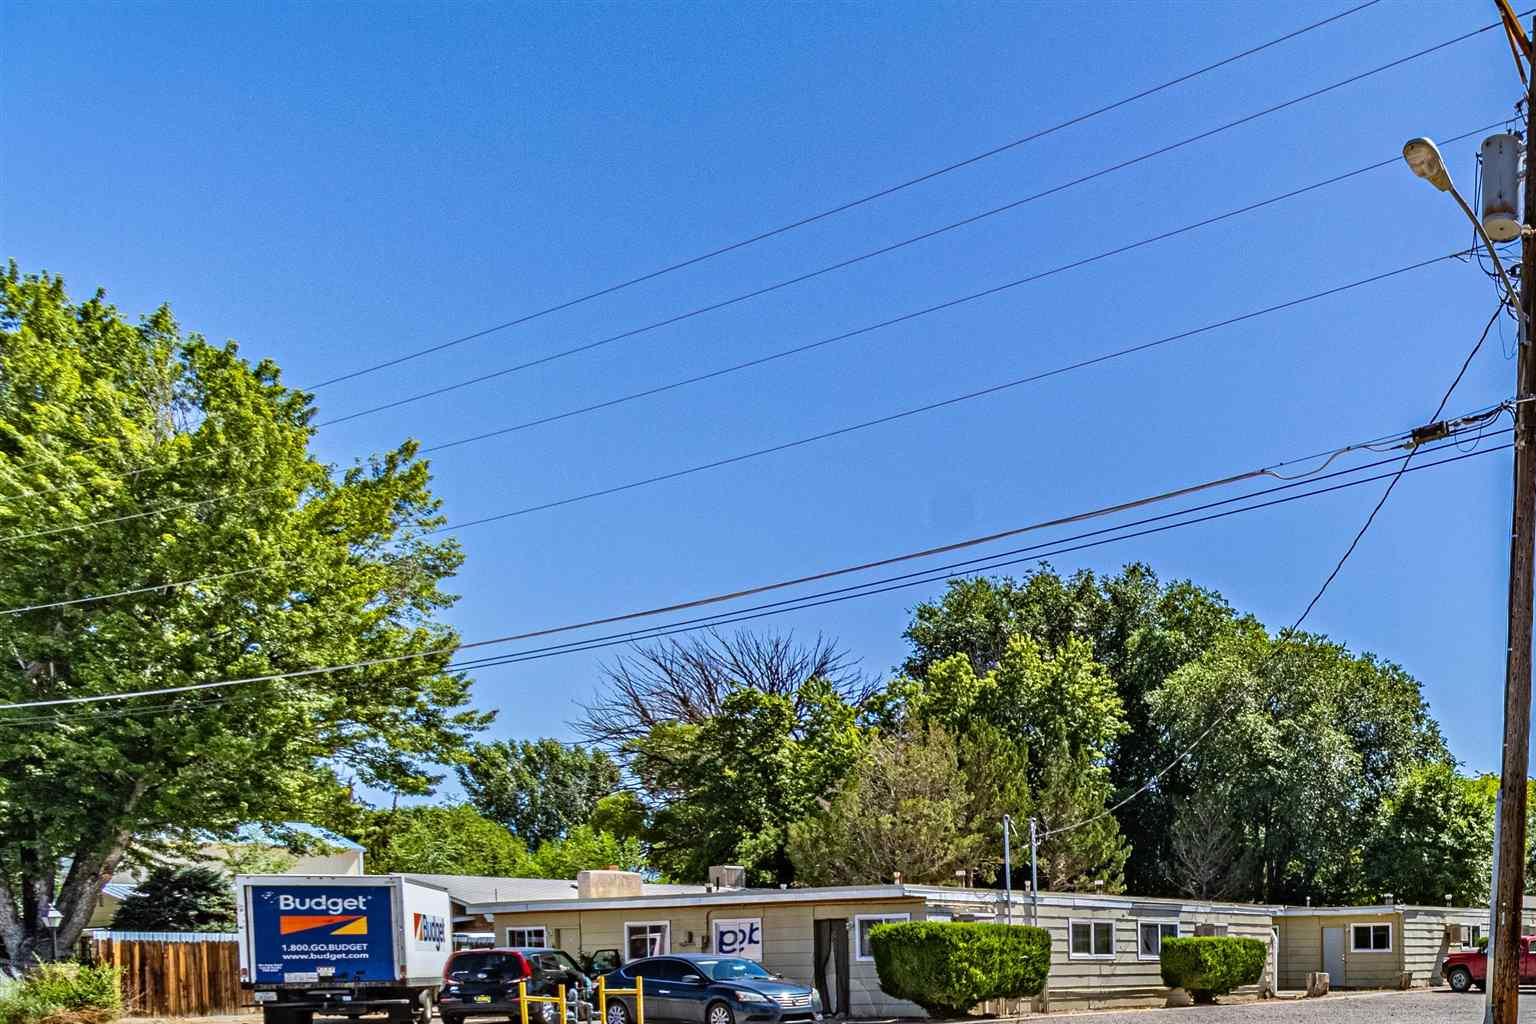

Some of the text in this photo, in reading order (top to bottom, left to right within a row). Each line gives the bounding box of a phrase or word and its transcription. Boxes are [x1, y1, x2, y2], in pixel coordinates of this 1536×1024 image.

[279, 894, 367, 915] Budget
[422, 913, 446, 952] Budget
[281, 943, 369, 952] 1.800.GO.BUDGET
[281, 952, 369, 961] www.budget.com
